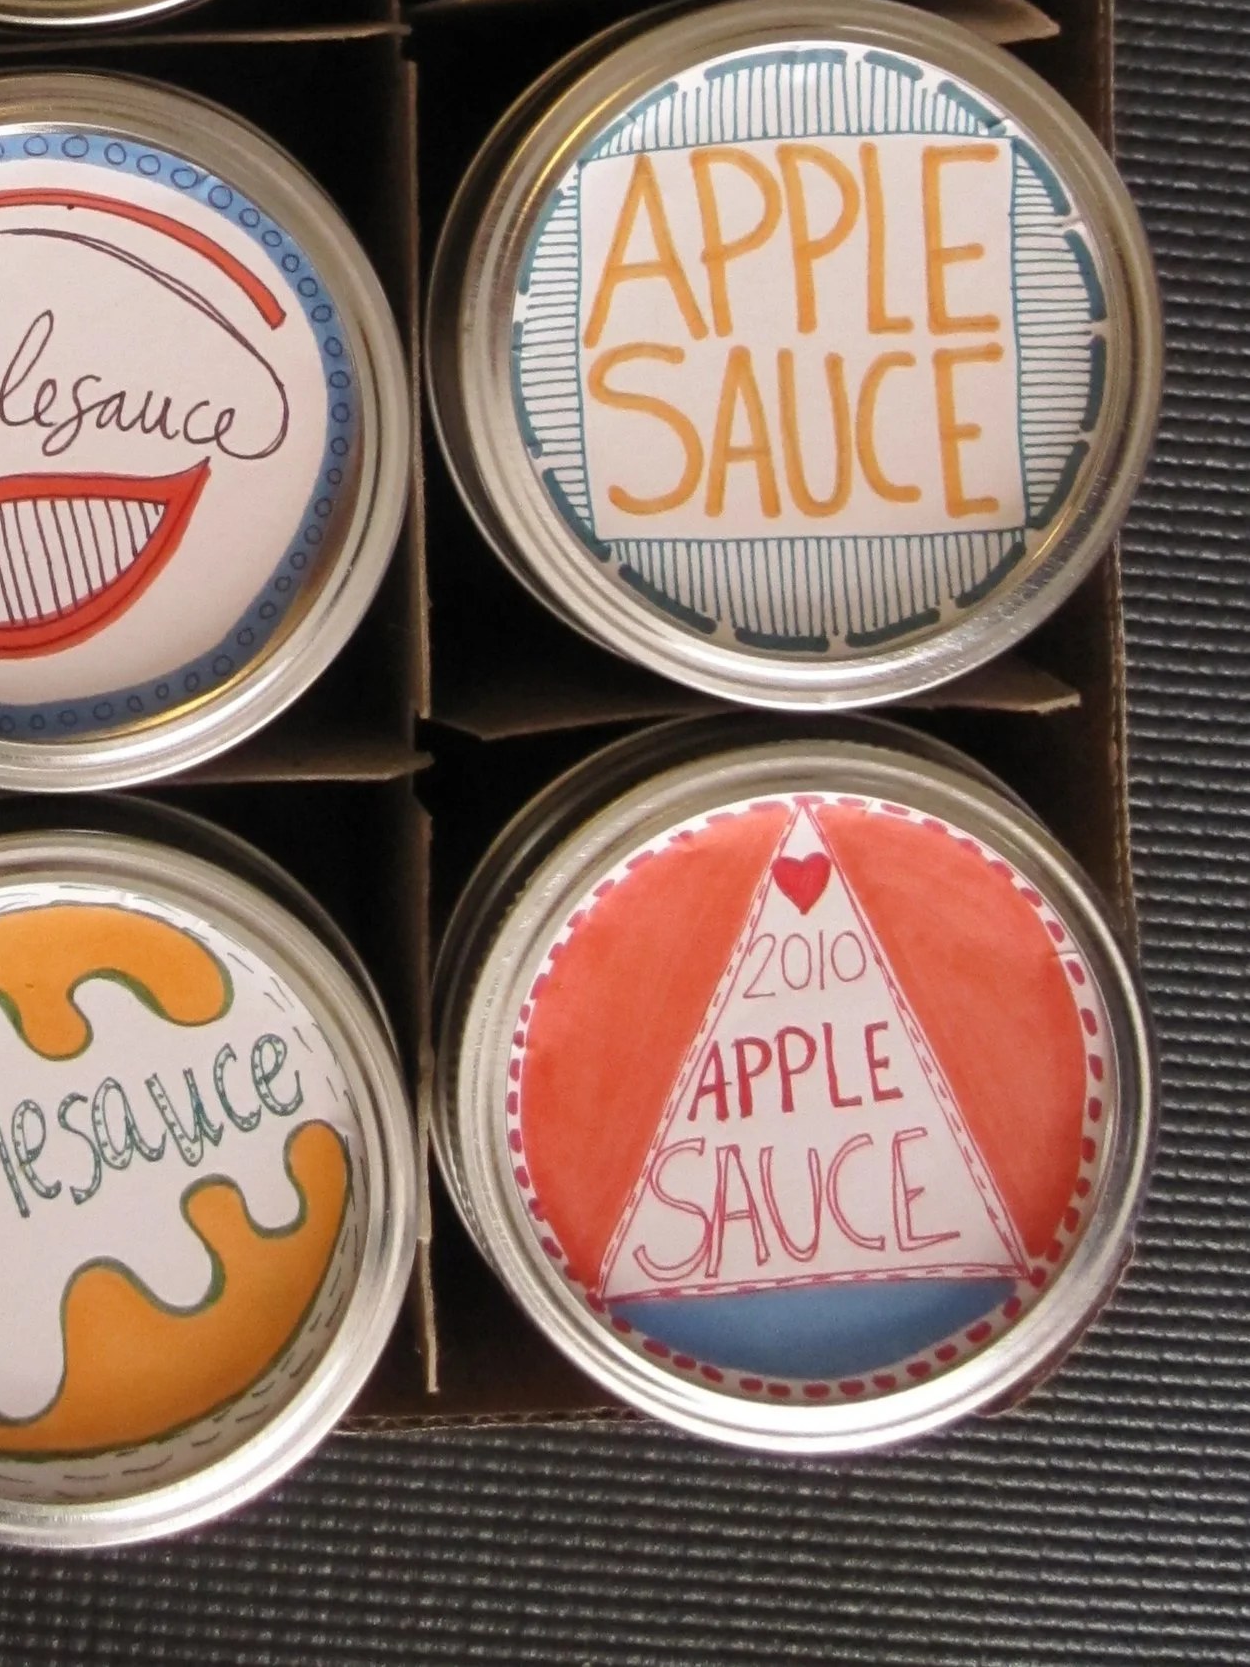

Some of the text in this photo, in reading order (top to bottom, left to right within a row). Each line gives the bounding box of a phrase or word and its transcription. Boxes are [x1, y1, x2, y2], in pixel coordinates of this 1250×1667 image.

[583, 142, 1000, 349] APPLE
[586, 342, 1004, 519] SAUCE
[742, 930, 867, 998] 2010
[687, 1021, 904, 1122] APPLE
[632, 1128, 960, 1281] SAUCE
